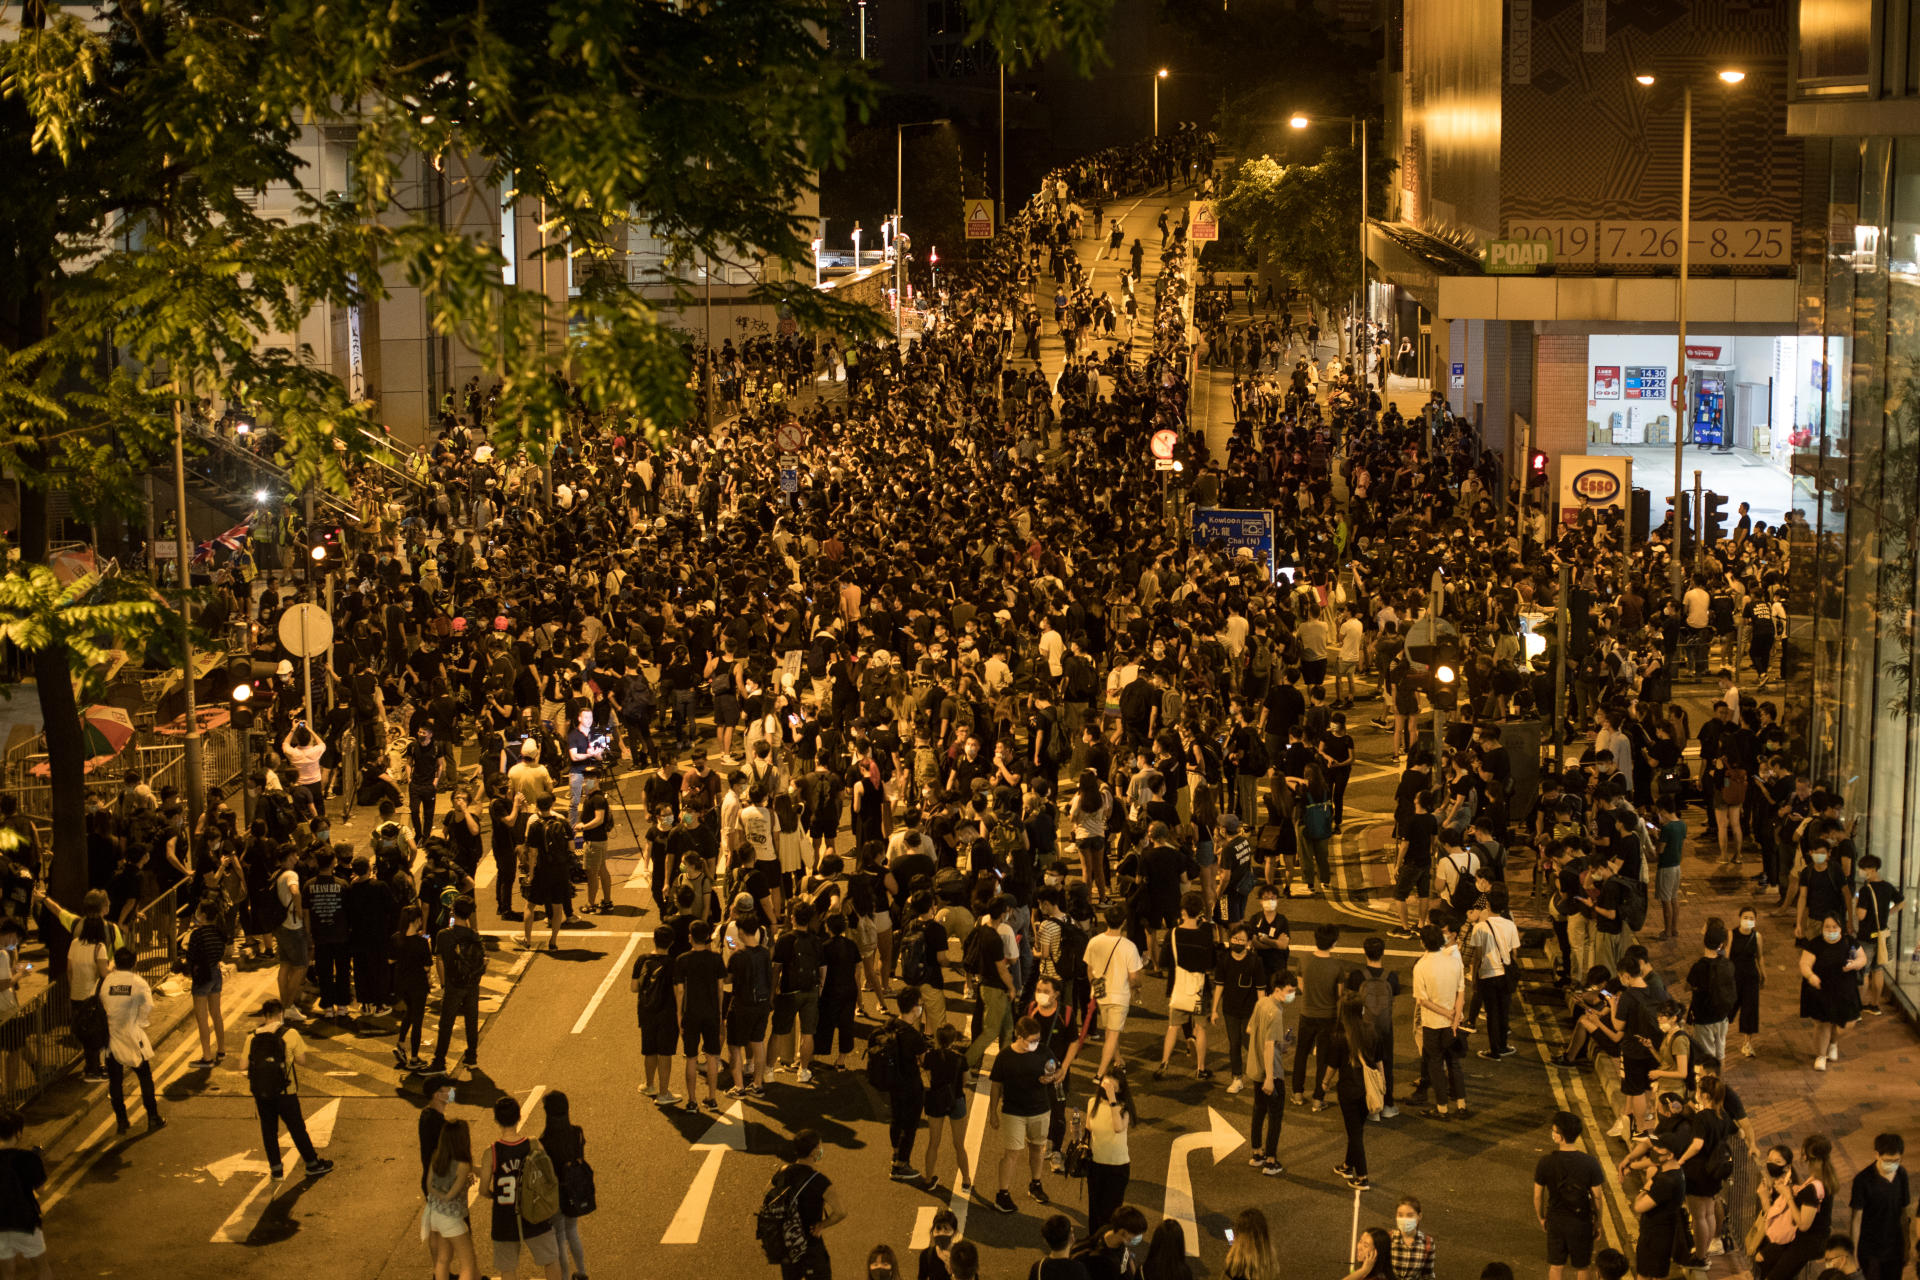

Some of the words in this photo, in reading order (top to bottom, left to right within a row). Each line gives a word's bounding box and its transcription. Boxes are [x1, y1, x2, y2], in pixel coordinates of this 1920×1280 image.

[1491, 243, 1548, 265] POAD
[1641, 370, 1665, 378] 14.30
[1641, 379, 1665, 388] 17.24
[1641, 389, 1665, 398] 18.43
[1580, 476, 1613, 493] Esso
